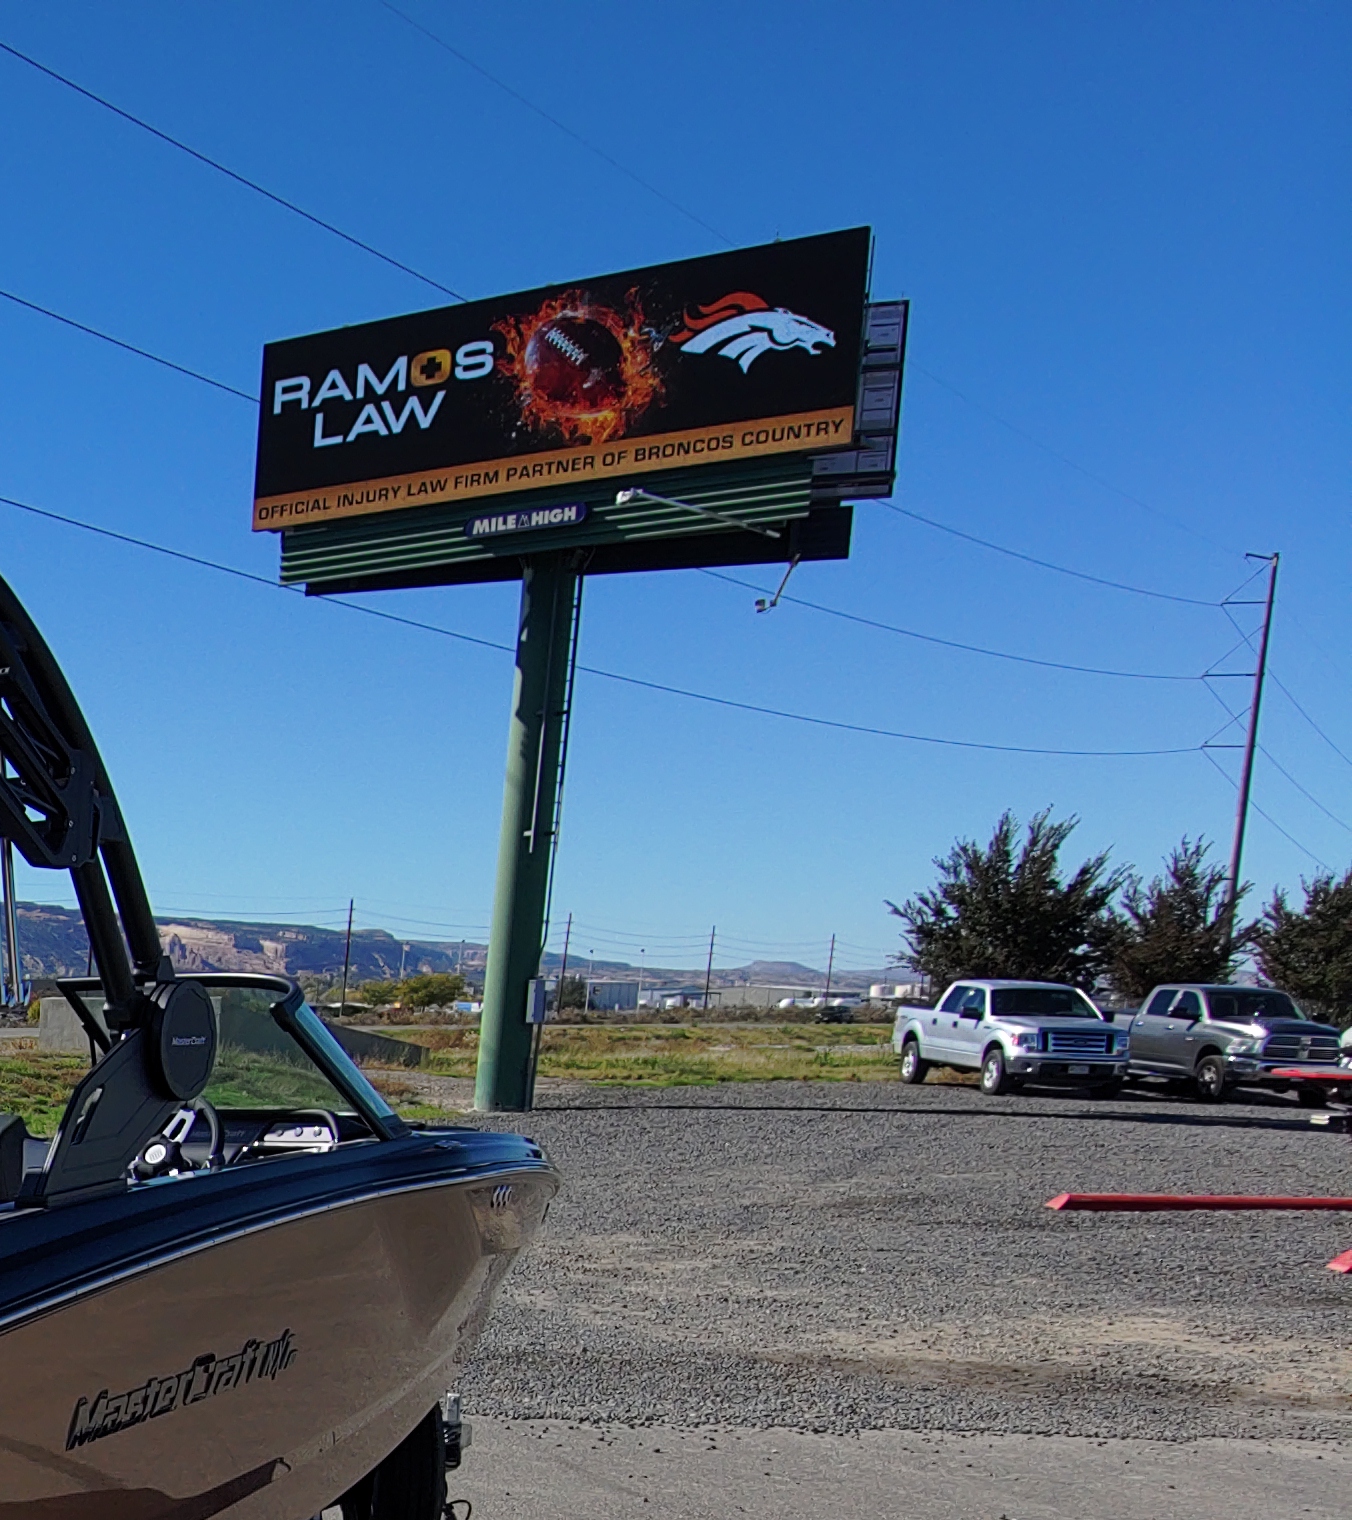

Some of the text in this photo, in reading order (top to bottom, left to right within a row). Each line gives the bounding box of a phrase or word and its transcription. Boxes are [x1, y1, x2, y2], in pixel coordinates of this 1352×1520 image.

[273, 340, 494, 416] RAMOS
[313, 390, 447, 448] LAW
[258, 418, 844, 521] OFFICIAL INJURY LAW FIRM PARTNER OF BRONCOS COUNTRY
[472, 505, 577, 535] MILE HIGH
[64, 1335, 268, 1452] MasterCraft
